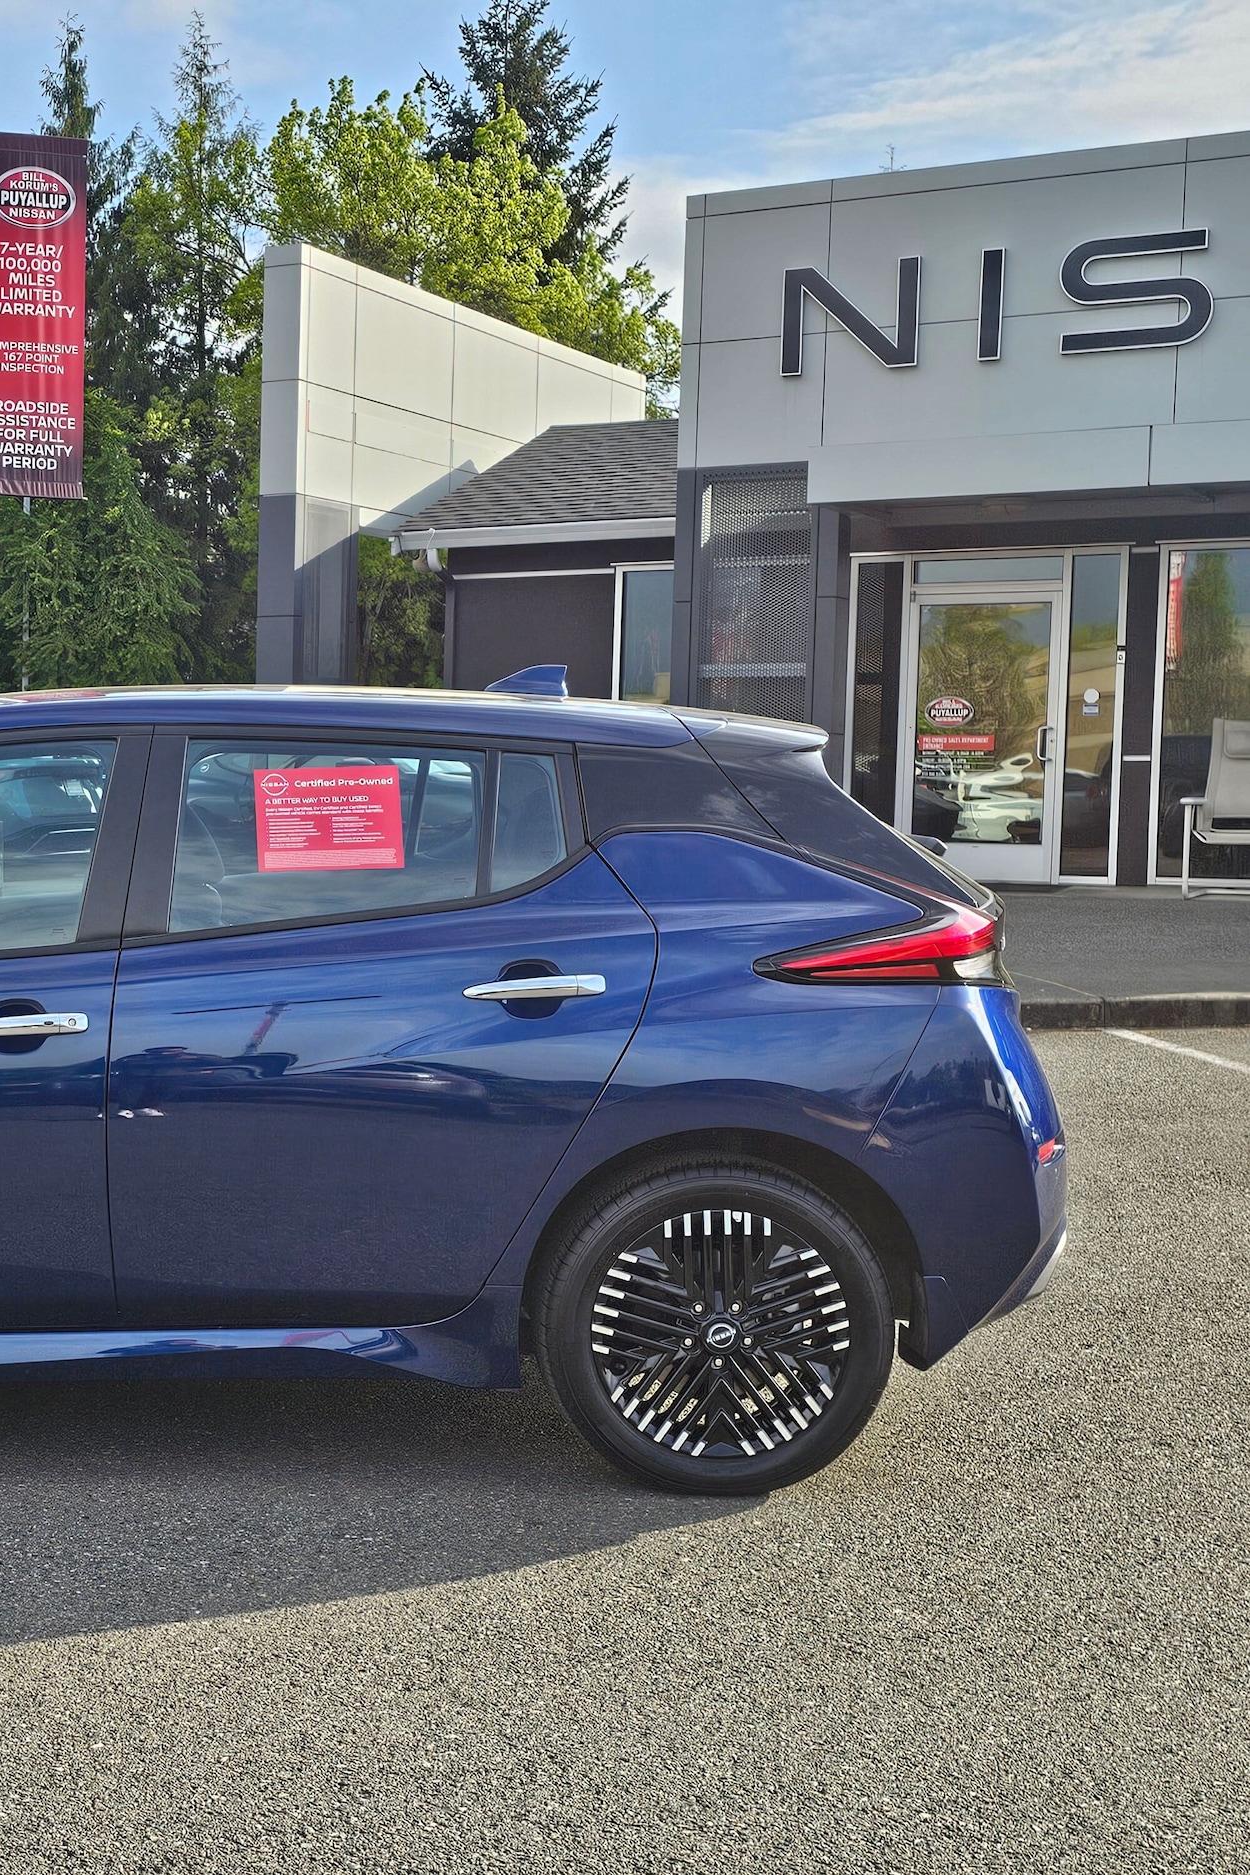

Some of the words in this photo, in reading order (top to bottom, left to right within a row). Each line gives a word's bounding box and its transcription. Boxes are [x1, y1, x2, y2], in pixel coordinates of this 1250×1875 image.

[22, 172, 46, 182] BILL
[10, 180, 59, 192] KORUM'S
[0, 190, 67, 210] PUYALLUP
[9, 207, 56, 220] NISSAN
[0, 241, 64, 259] 7-YEAR/
[8, 272, 56, 287] MILES
[0, 286, 62, 303] LIMITED
[780, 227, 1214, 377] NIS
[3, 352, 23, 362] 167
[25, 353, 60, 364] POINT
[29, 429, 65, 443] FULL
[2, 456, 58, 470] PERIOD
[930, 708, 969, 717] PUYALLUP
[294, 779, 336, 788] Certified
[338, 776, 393, 787] Pre-Owned
[272, 797, 301, 805] BETTER
